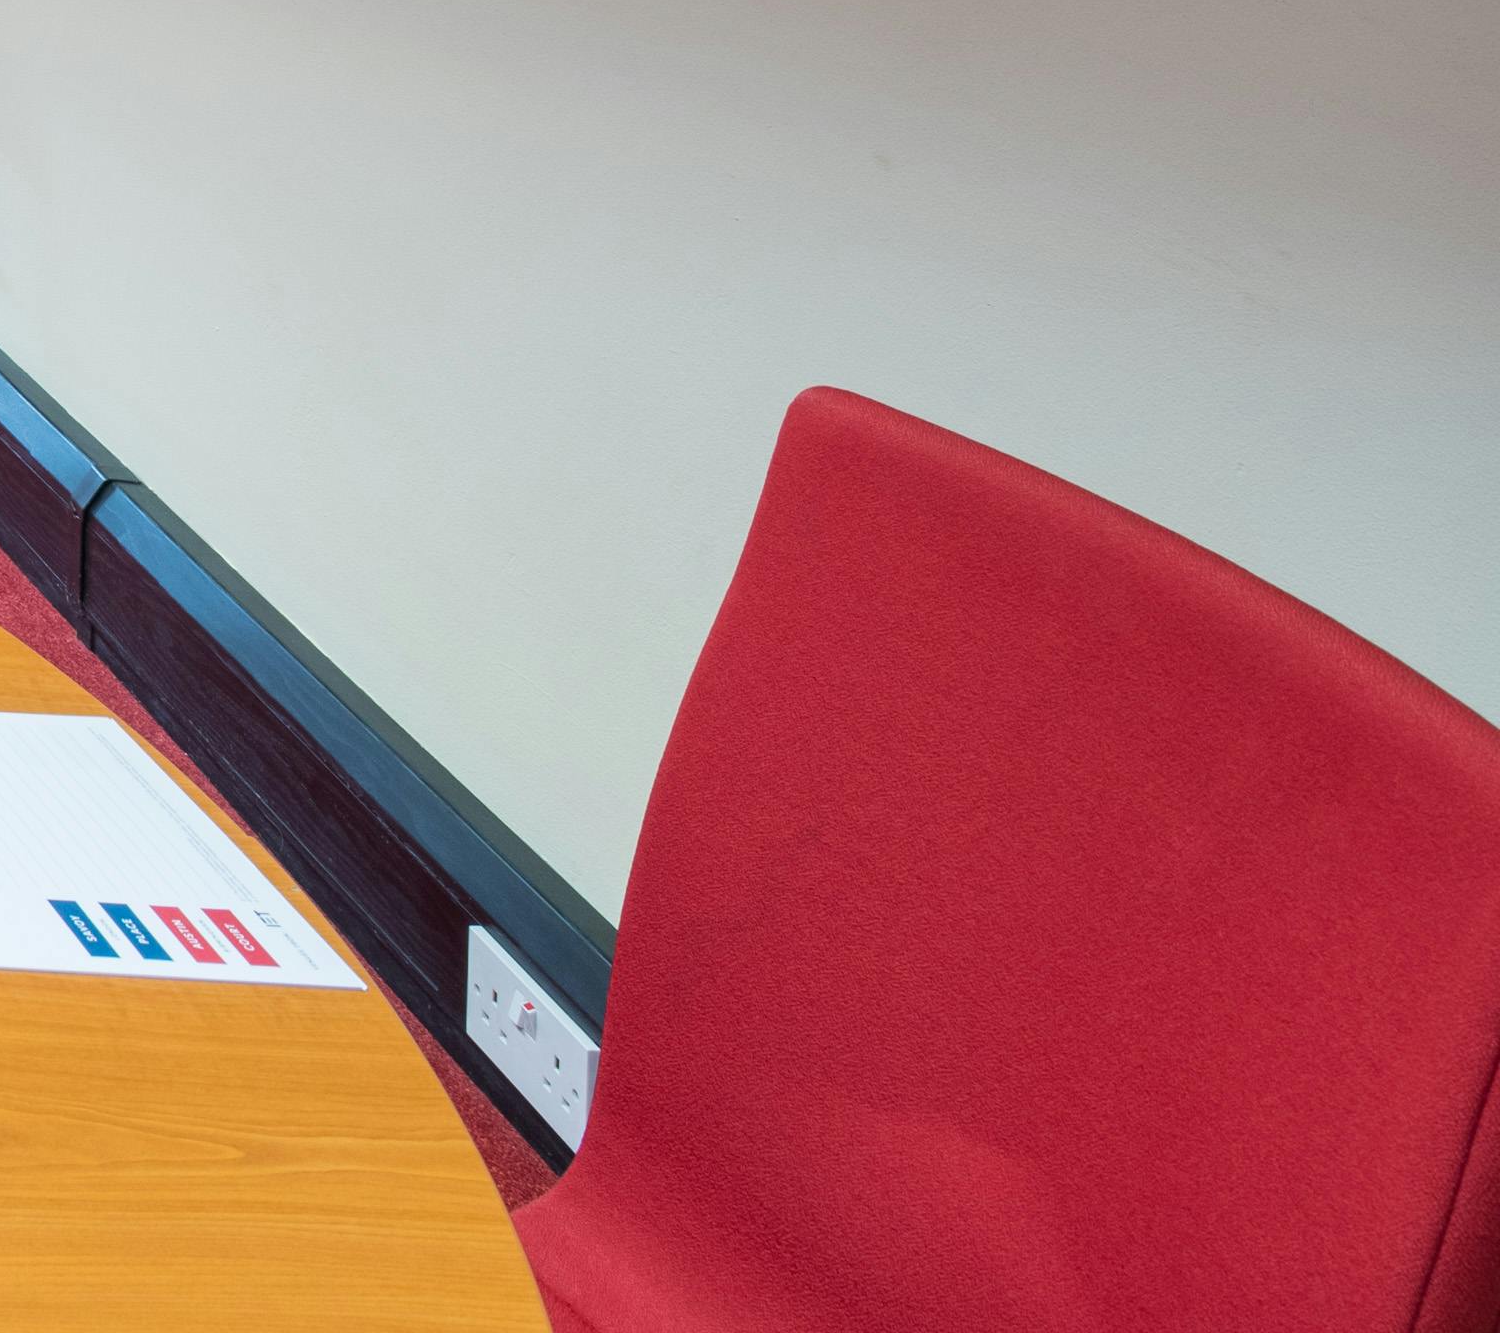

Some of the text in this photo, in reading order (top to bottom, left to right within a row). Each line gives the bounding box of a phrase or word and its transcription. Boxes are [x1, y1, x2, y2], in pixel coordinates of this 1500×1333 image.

[69, 914, 98, 942] SAVOY
[121, 918, 149, 945] PLACE
[253, 910, 282, 928] IET
[171, 919, 204, 950] AUSTIN
[223, 922, 255, 952] COURT
